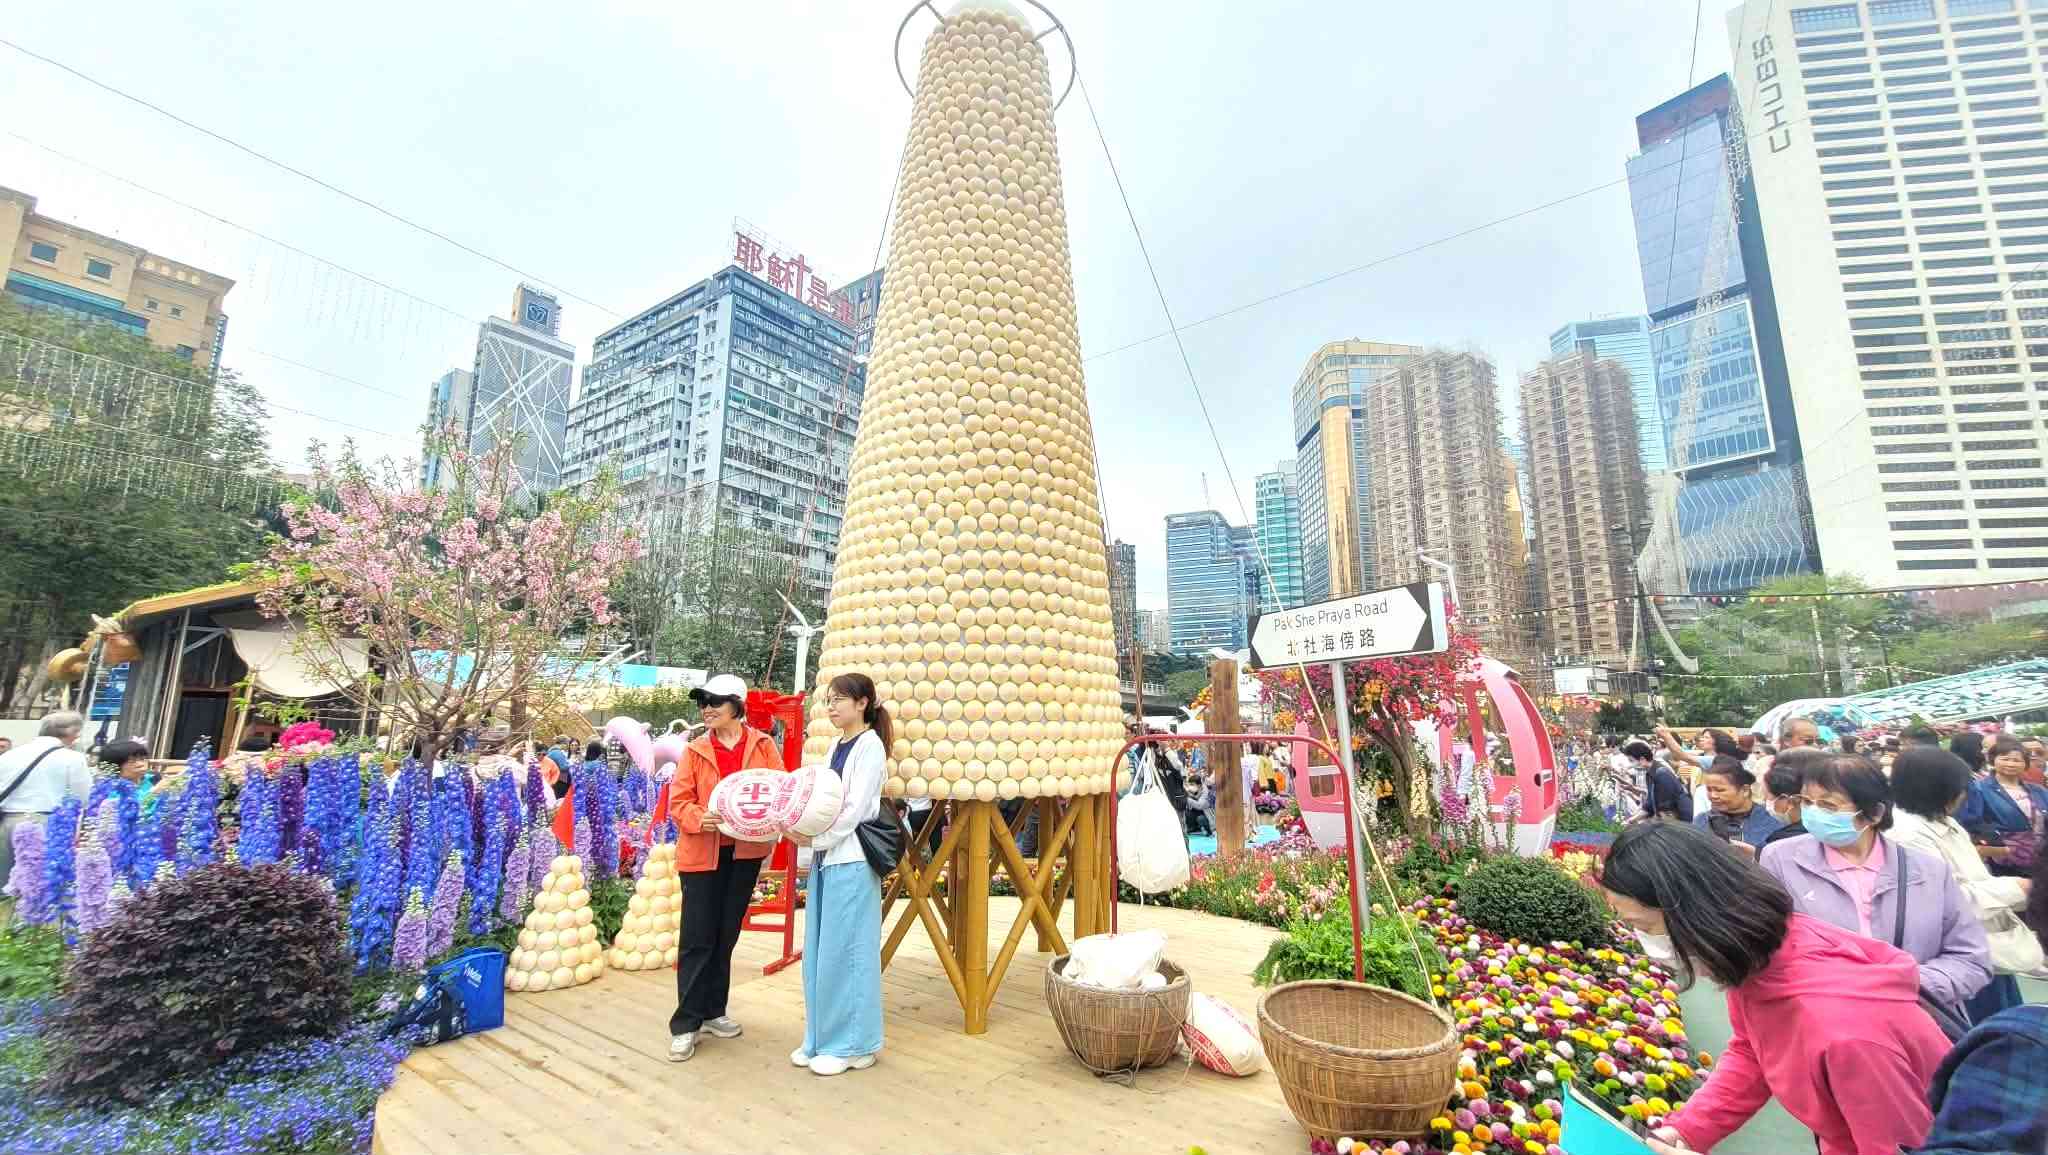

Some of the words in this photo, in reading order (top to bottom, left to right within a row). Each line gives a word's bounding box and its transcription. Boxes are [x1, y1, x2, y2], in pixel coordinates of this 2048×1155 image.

[1274, 615, 1293, 632] Pak
[1295, 614, 1315, 628] She
[1318, 608, 1351, 625] Praya
[1354, 599, 1388, 617] Road
[1287, 628, 1375, 656] 北社海傍路
